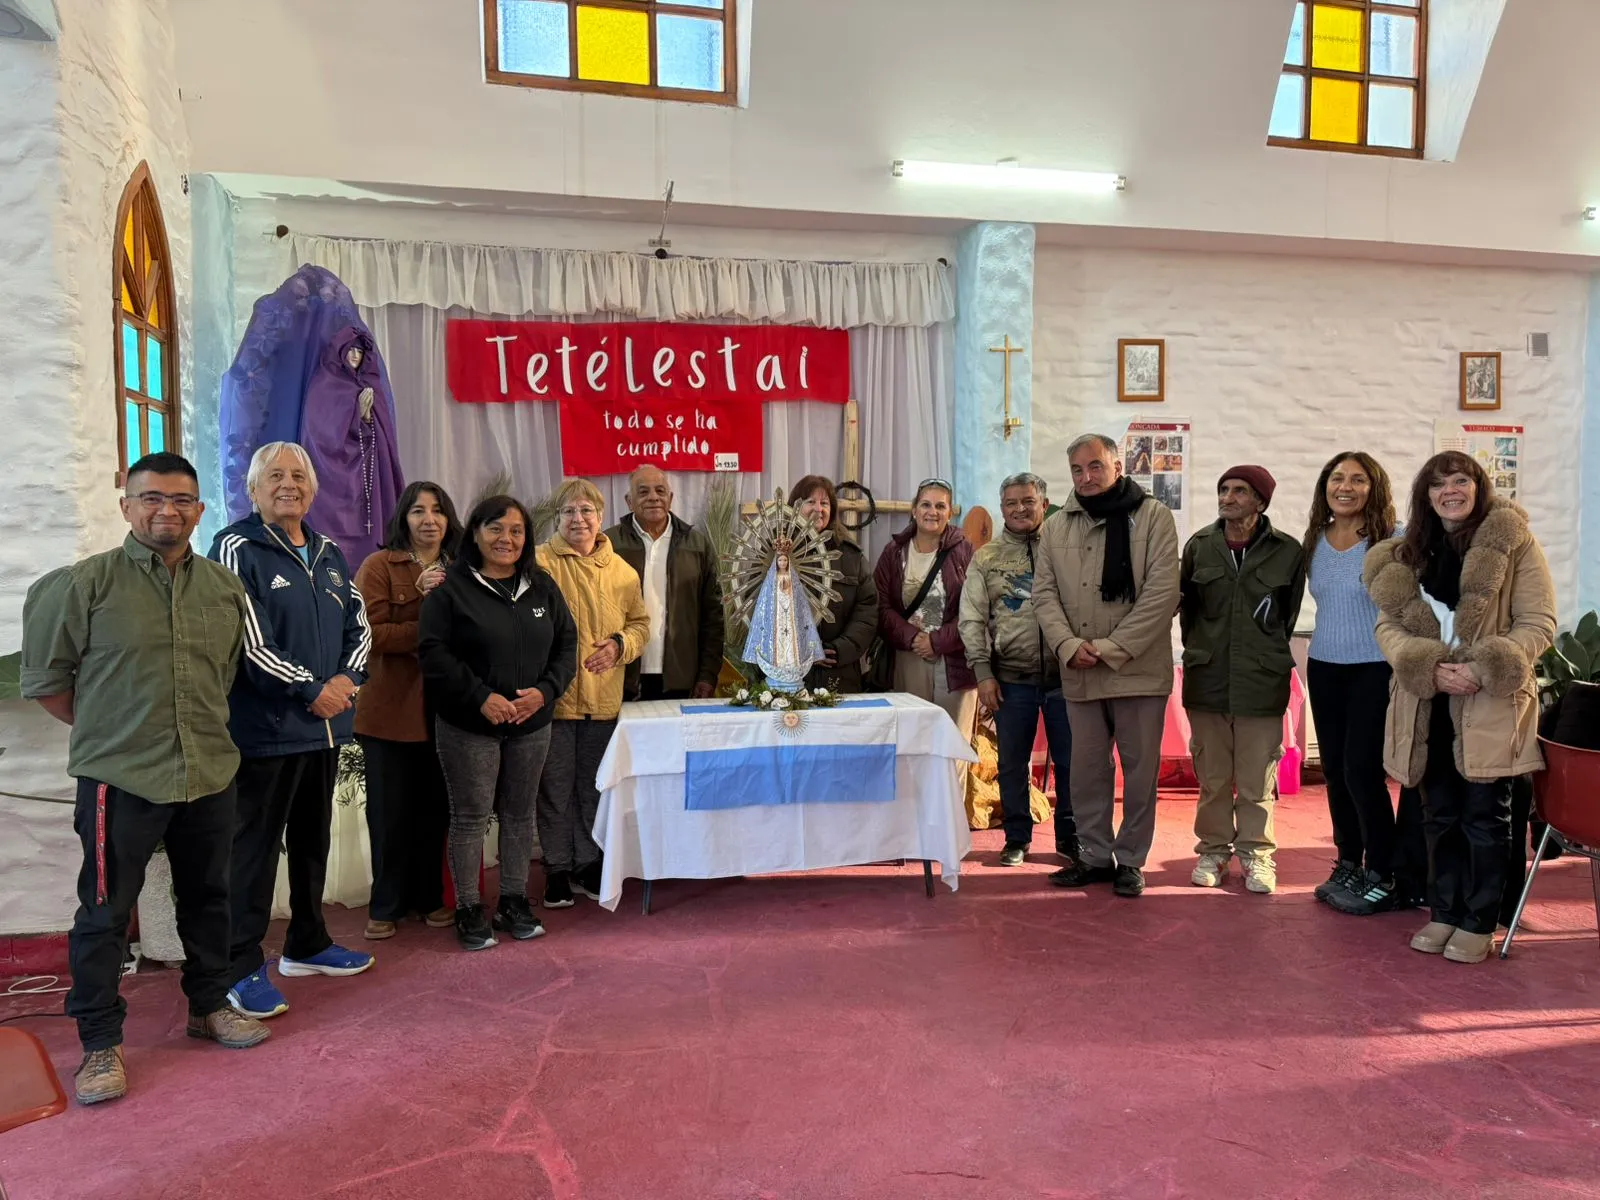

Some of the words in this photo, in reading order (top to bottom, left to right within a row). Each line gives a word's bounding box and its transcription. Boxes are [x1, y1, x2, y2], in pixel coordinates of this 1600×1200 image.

[485, 334, 809, 395] Tetélestai
[602, 409, 654, 430] todo
[666, 413, 685, 430] se
[695, 408, 718, 430] ha
[616, 433, 710, 462] cumplido
